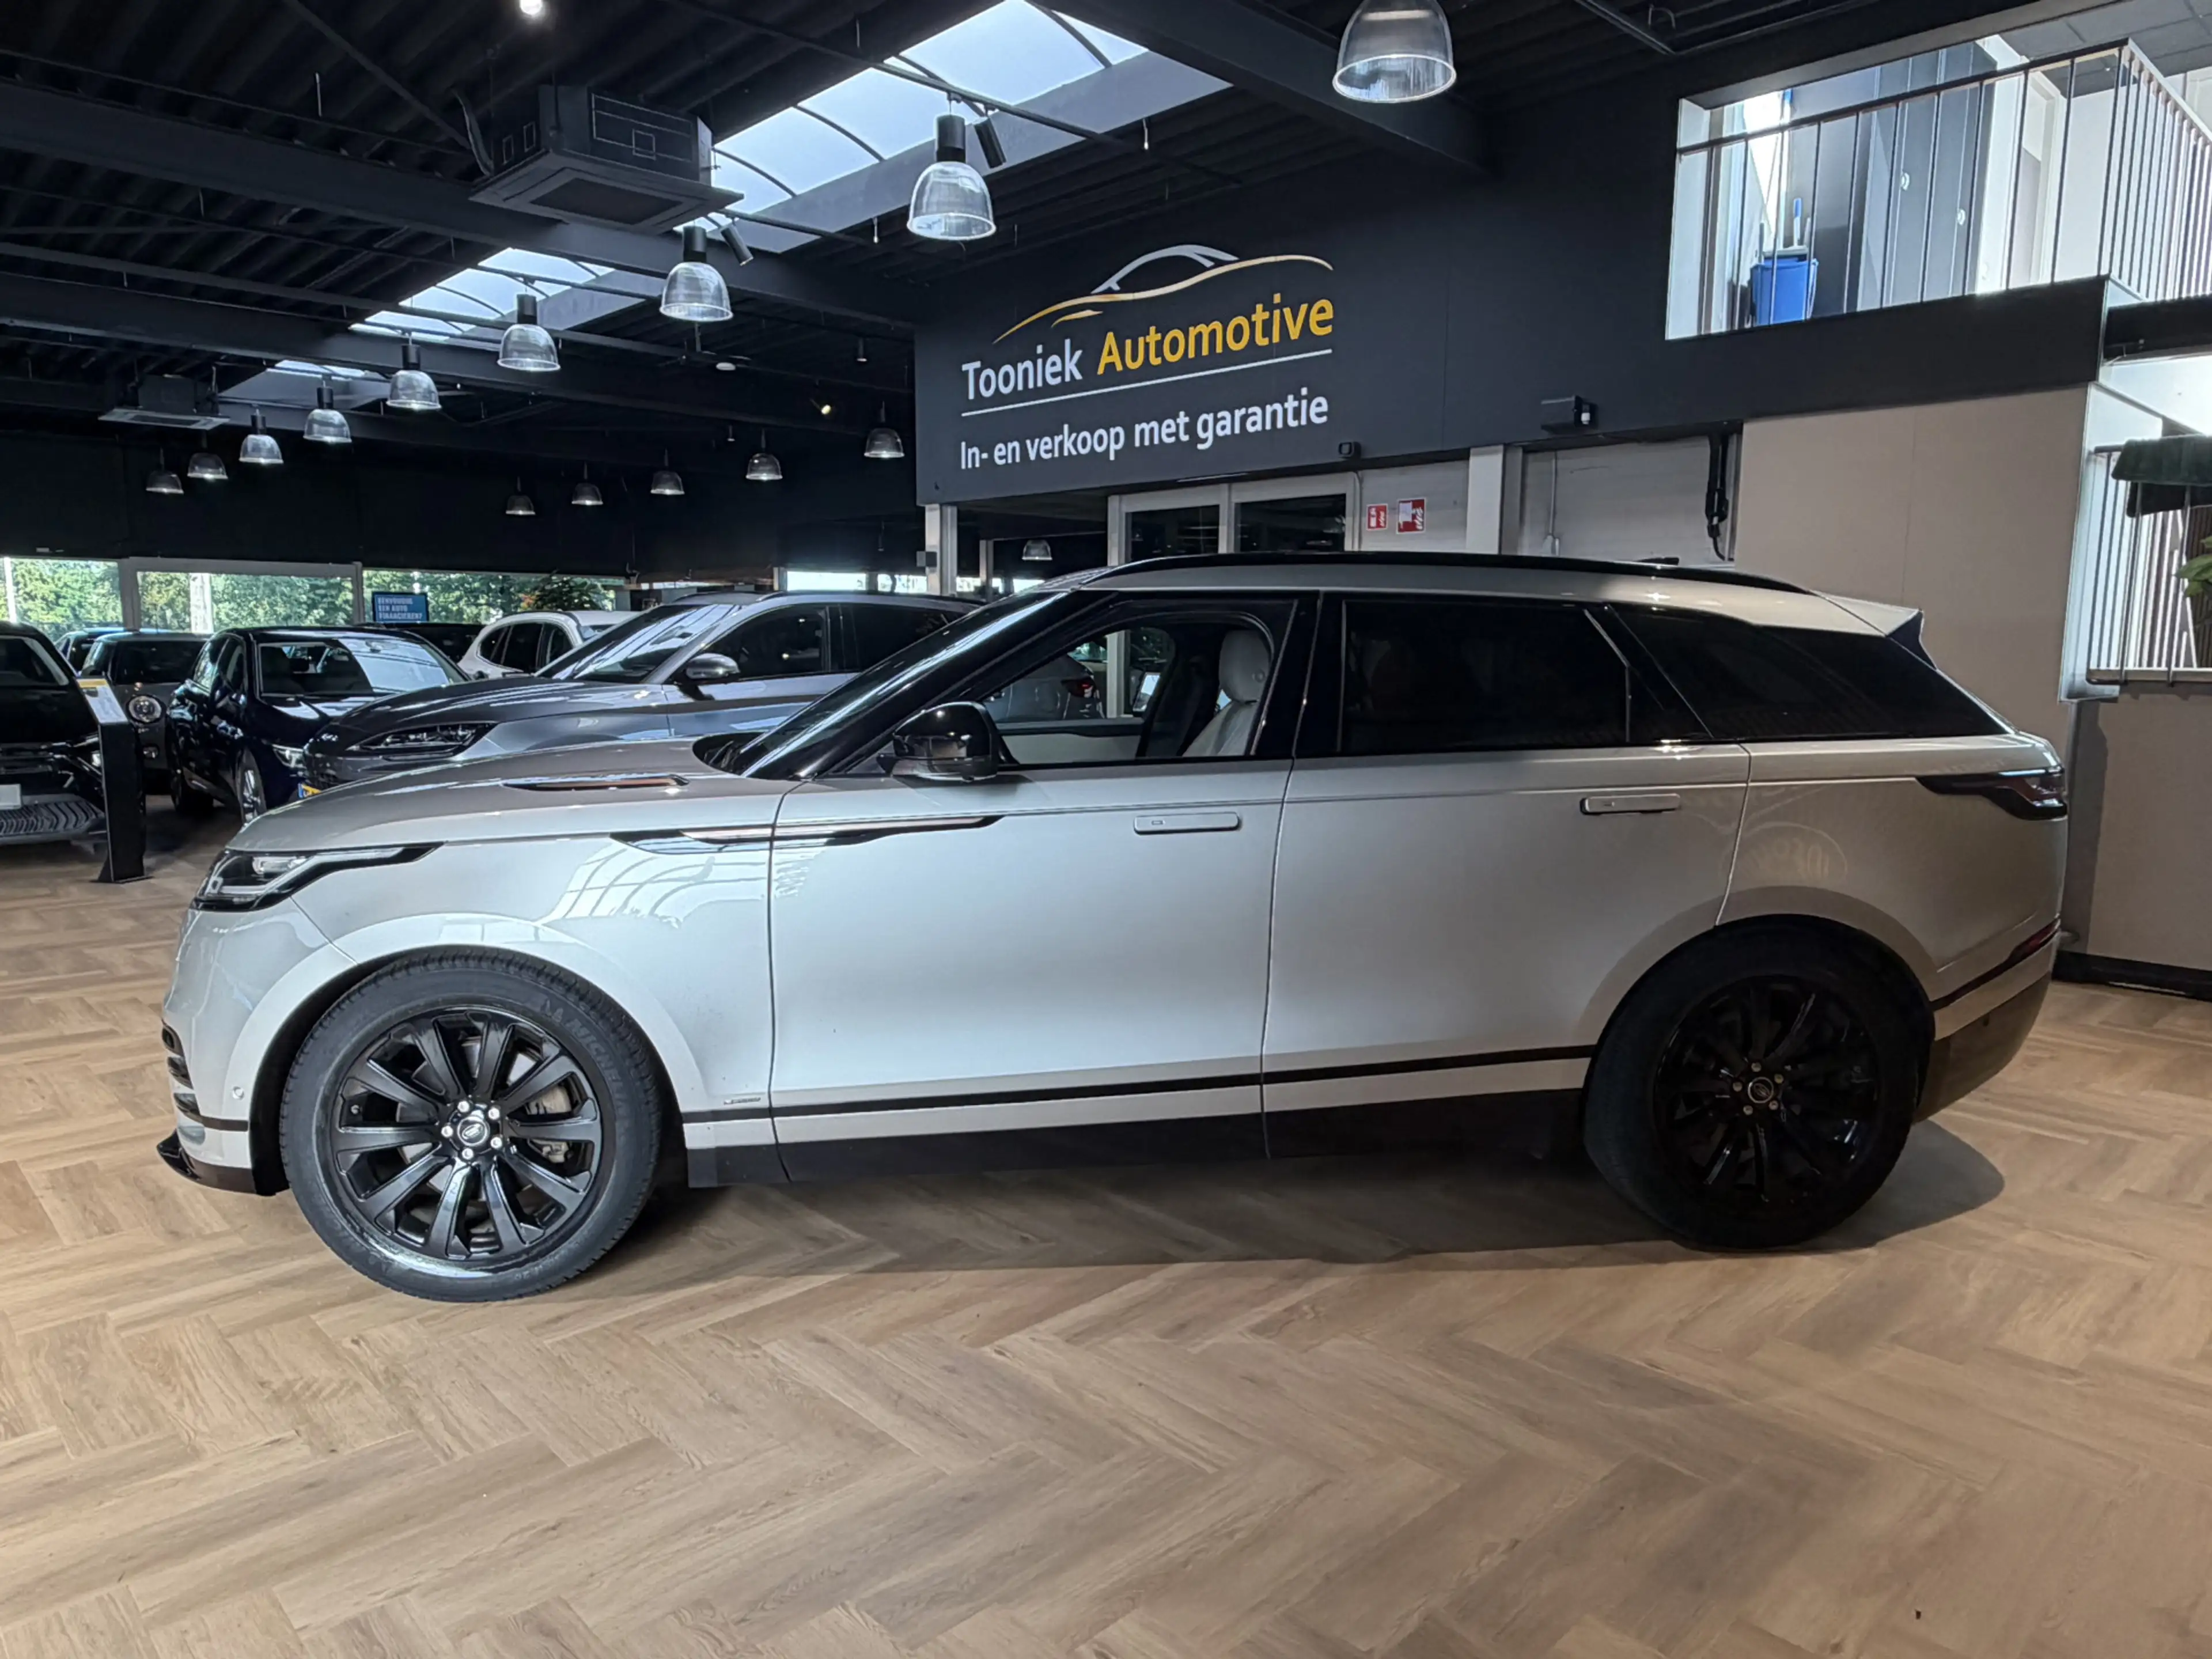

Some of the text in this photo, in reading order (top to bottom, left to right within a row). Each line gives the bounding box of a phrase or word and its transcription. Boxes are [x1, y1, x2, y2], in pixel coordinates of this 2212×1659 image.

[961, 292, 1334, 400] Tooniek Automotive
[960, 387, 1329, 470] In- en verkoop met garantie
